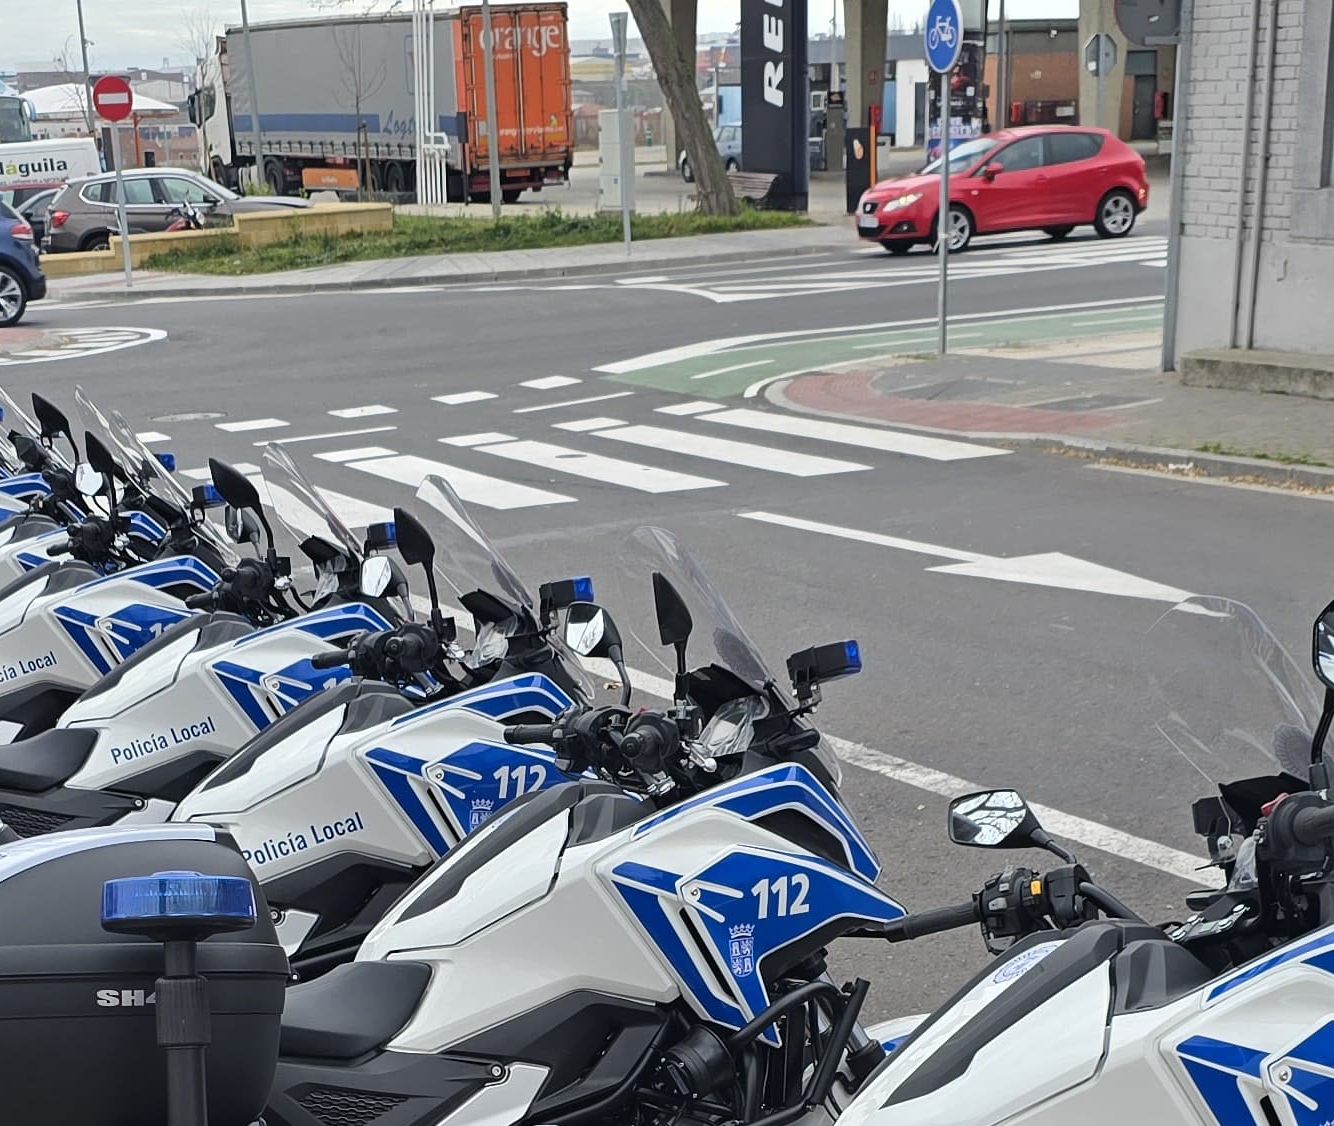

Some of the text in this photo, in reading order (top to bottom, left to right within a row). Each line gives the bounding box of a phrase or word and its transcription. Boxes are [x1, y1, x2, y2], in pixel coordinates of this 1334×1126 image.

[18, 650, 57, 674] Local
[110, 716, 216, 765] Policía Local
[493, 764, 547, 799] 112
[240, 811, 364, 864] Policía Local
[751, 873, 810, 919] 112
